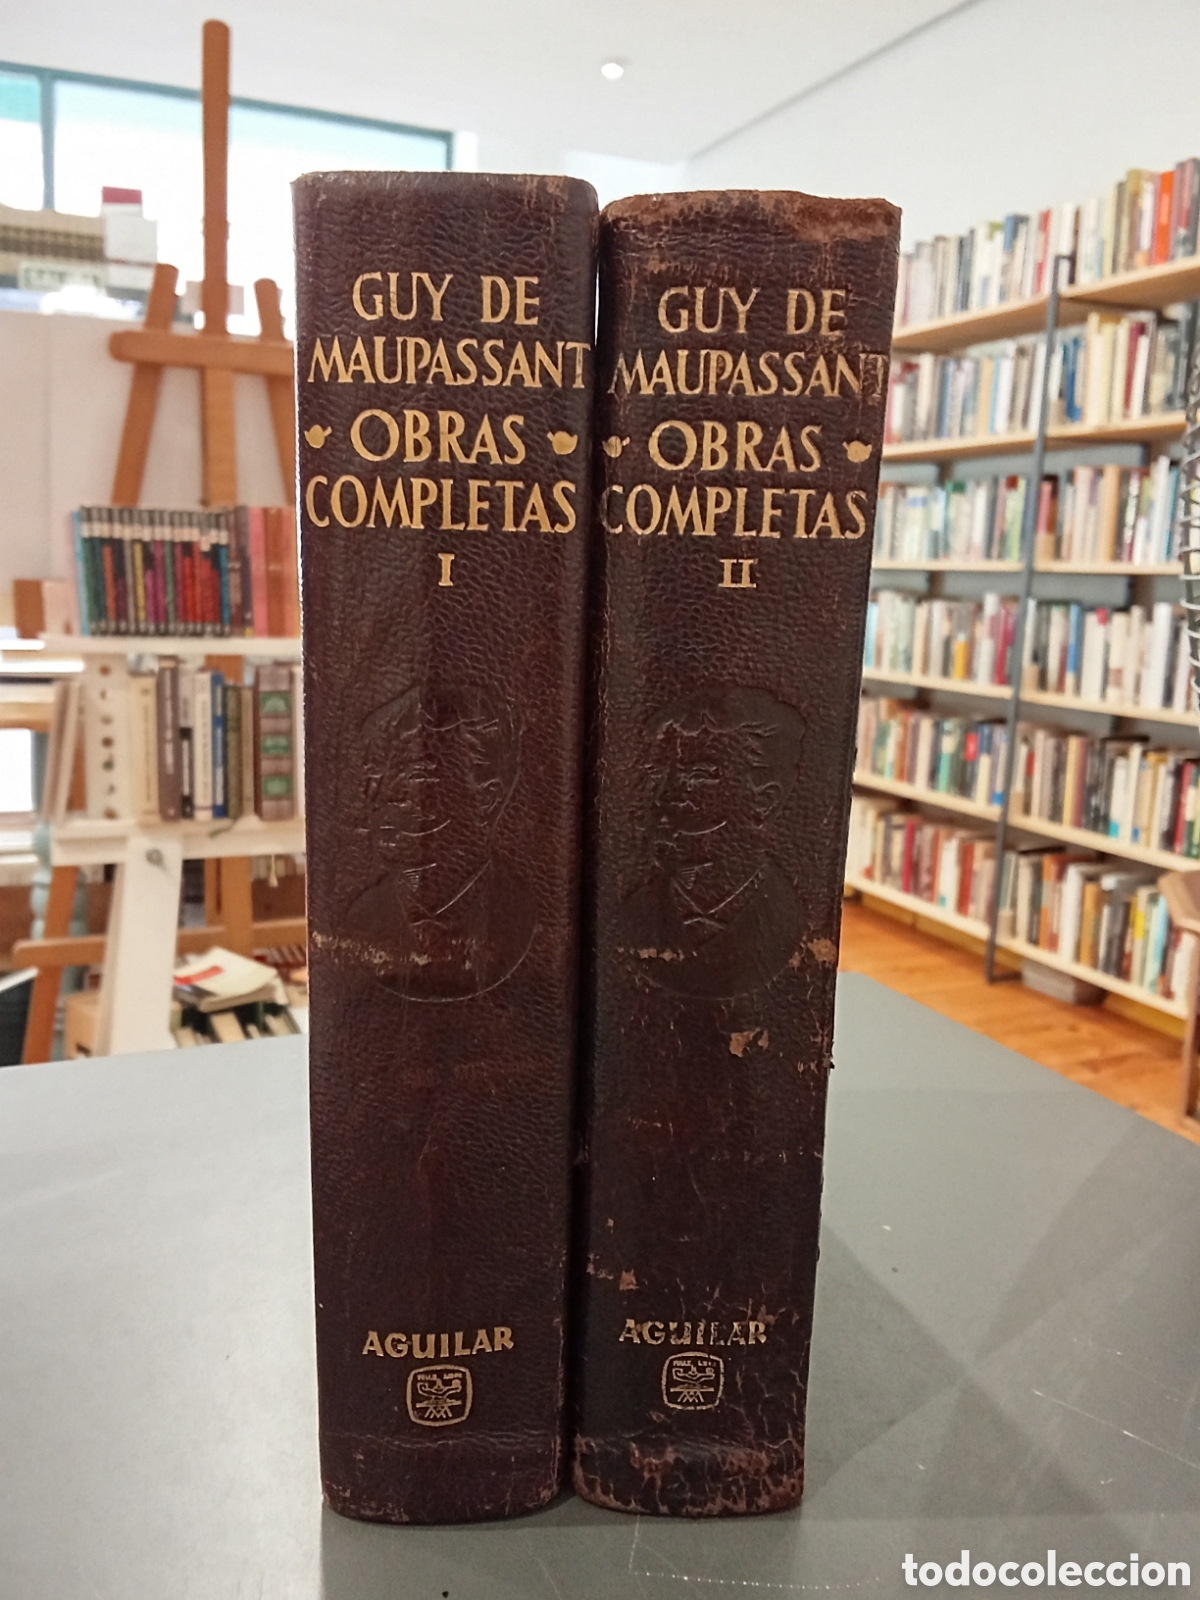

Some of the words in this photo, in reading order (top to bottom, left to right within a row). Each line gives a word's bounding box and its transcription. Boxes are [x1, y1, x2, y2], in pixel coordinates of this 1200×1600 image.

[352, 272, 453, 322] GUY
[481, 275, 540, 325] DE
[657, 285, 760, 334] GUY
[786, 288, 846, 337] DE
[307, 335, 591, 389] MAUPASSANT
[607, 349, 889, 398] MAUPASSANT
[350, 408, 526, 465] OBRAS
[648, 419, 822, 473] OBRAS
[305, 475, 576, 534] COMPLETAS
[601, 484, 868, 540] COMPLETAS
[437, 553, 455, 587] I
[717, 558, 759, 588] II
[362, 1326, 515, 1359] AGUILAR
[618, 1318, 768, 1346] AGUILAR
